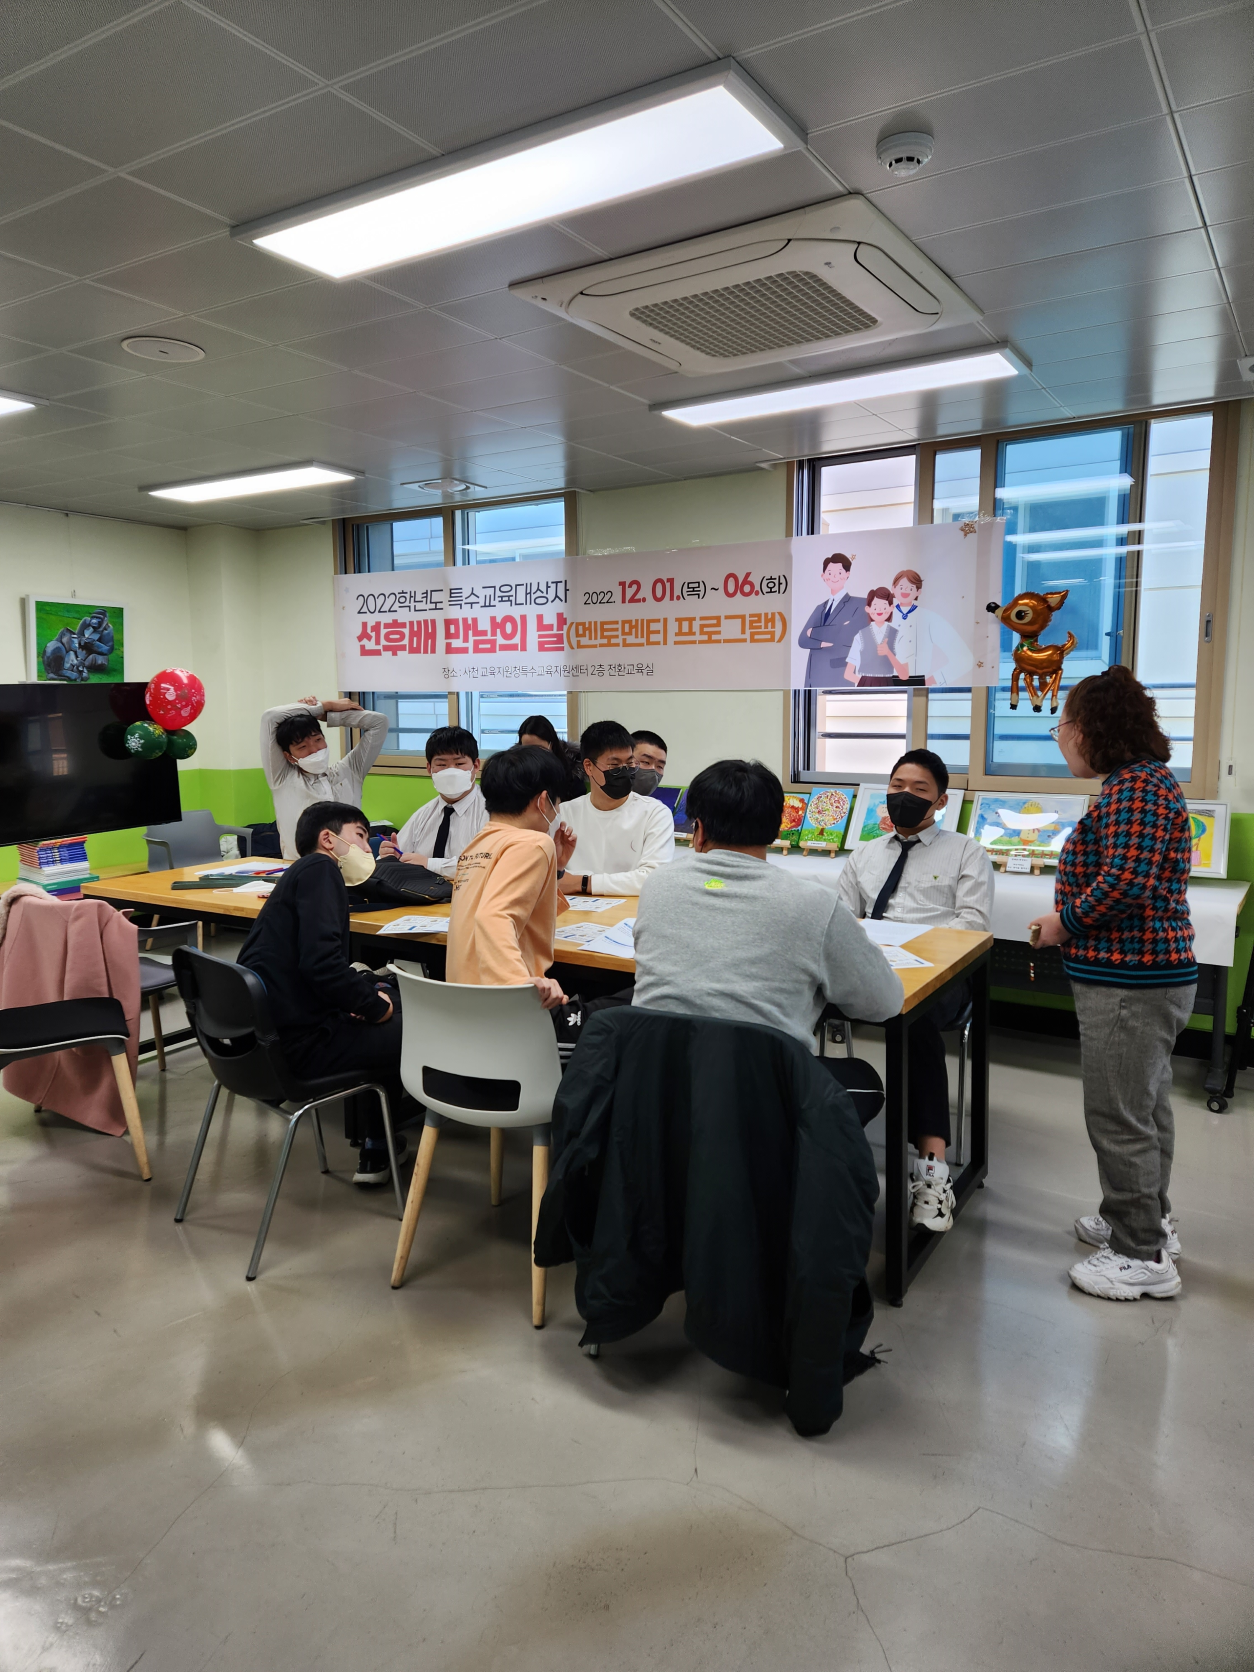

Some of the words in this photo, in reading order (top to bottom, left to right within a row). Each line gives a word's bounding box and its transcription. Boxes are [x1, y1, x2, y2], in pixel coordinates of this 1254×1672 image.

[356, 588, 444, 615] 2022학년도
[448, 580, 570, 610] 특수교육대상자
[583, 590, 616, 605] 2022.
[618, 579, 647, 604] 12.
[651, 577, 707, 603] 01.(목)
[723, 572, 788, 598] 06.(화)
[356, 618, 437, 657] 선후배
[443, 614, 528, 655] 만남의
[673, 611, 788, 646] 프로그램)
[463, 667, 479, 679] 사천
[590, 663, 606, 678] 2층
[607, 662, 654, 677] 전환교육실
